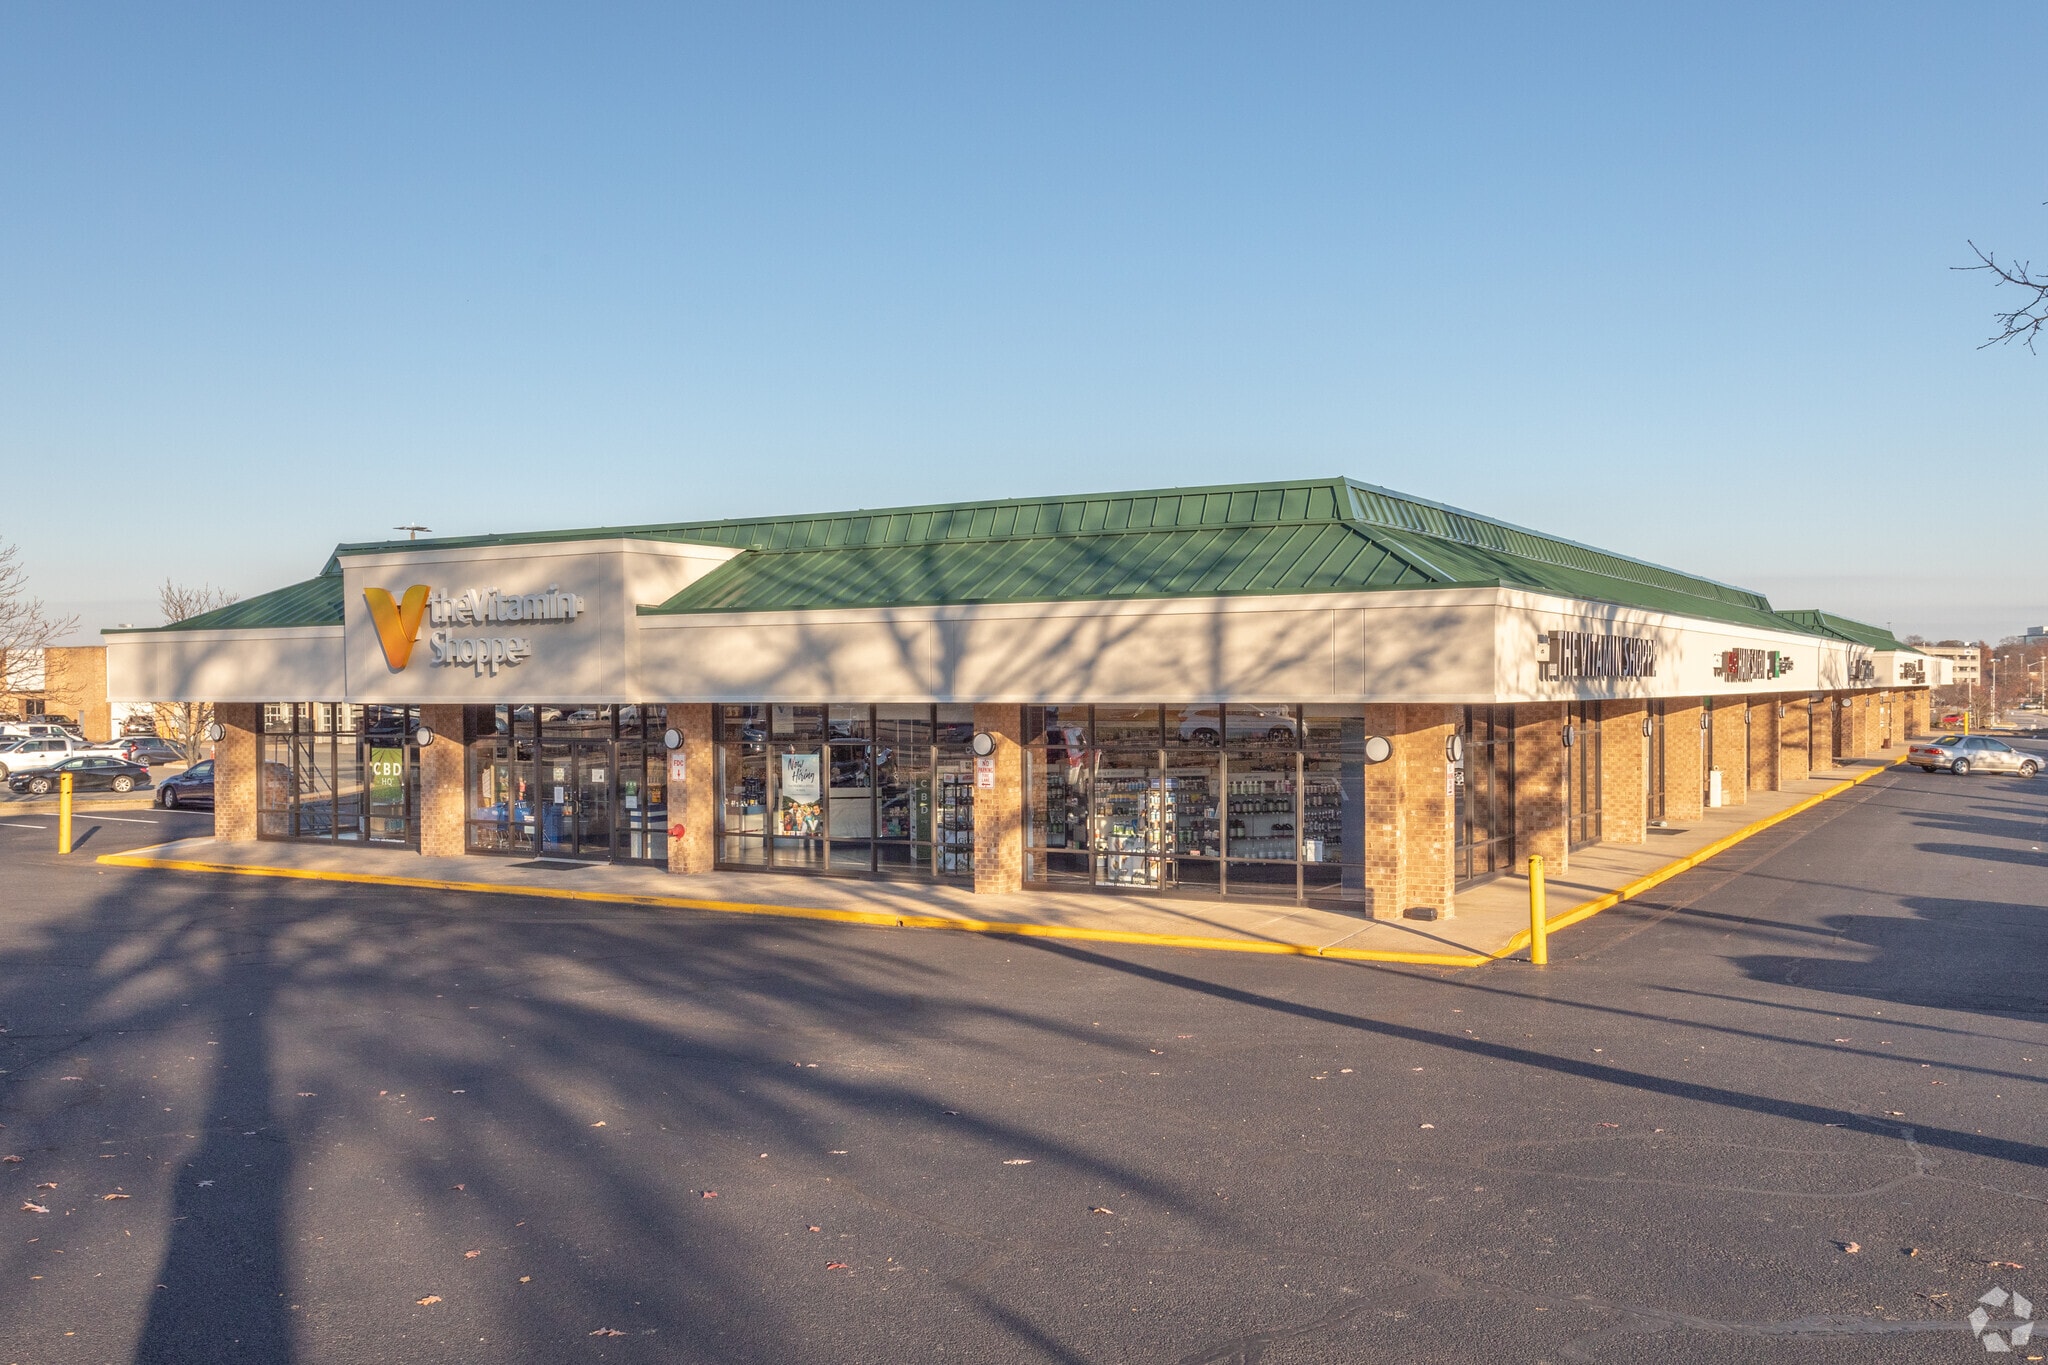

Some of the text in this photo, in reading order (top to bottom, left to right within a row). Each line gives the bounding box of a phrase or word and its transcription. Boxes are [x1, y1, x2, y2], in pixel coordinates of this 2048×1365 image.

[430, 629, 526, 673] Shoppe
[1557, 630, 1657, 677] THE VITAMIN SHOPPE
[373, 762, 402, 776] CBD
[673, 759, 684, 767] FDC
[787, 758, 804, 771] Now
[381, 778, 393, 786] HQ
[792, 769, 815, 783] Hiring
